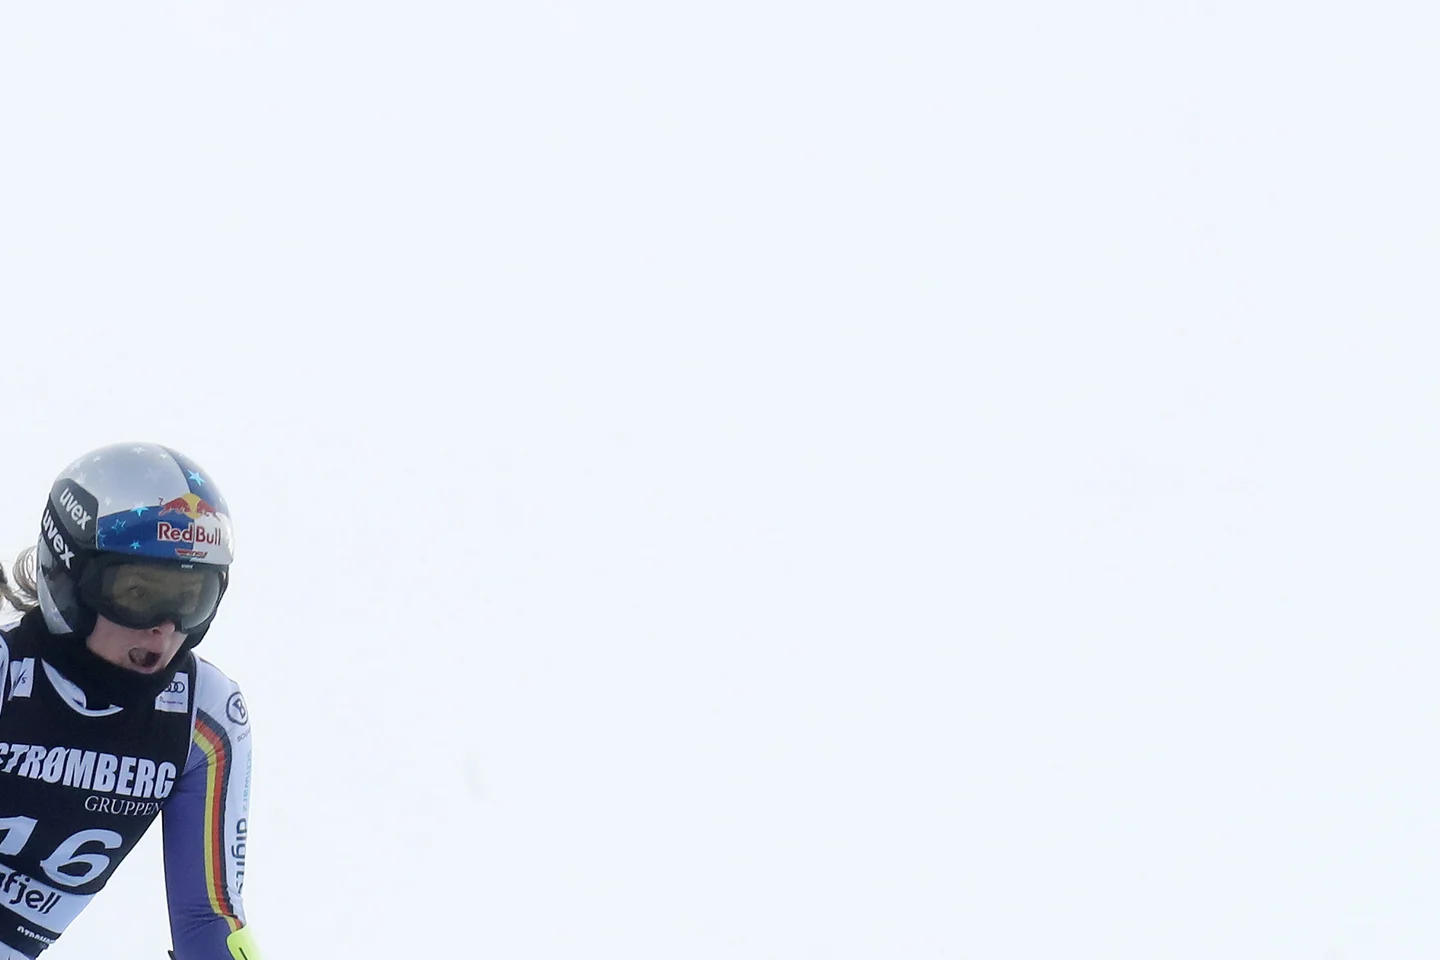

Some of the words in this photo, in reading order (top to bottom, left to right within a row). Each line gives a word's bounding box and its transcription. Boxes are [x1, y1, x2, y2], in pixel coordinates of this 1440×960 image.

[60, 487, 92, 531] uvex
[42, 509, 75, 569] uvex
[158, 522, 193, 543] Red
[195, 525, 221, 546] Bull
[84, 796, 165, 816] GRUPPEN
